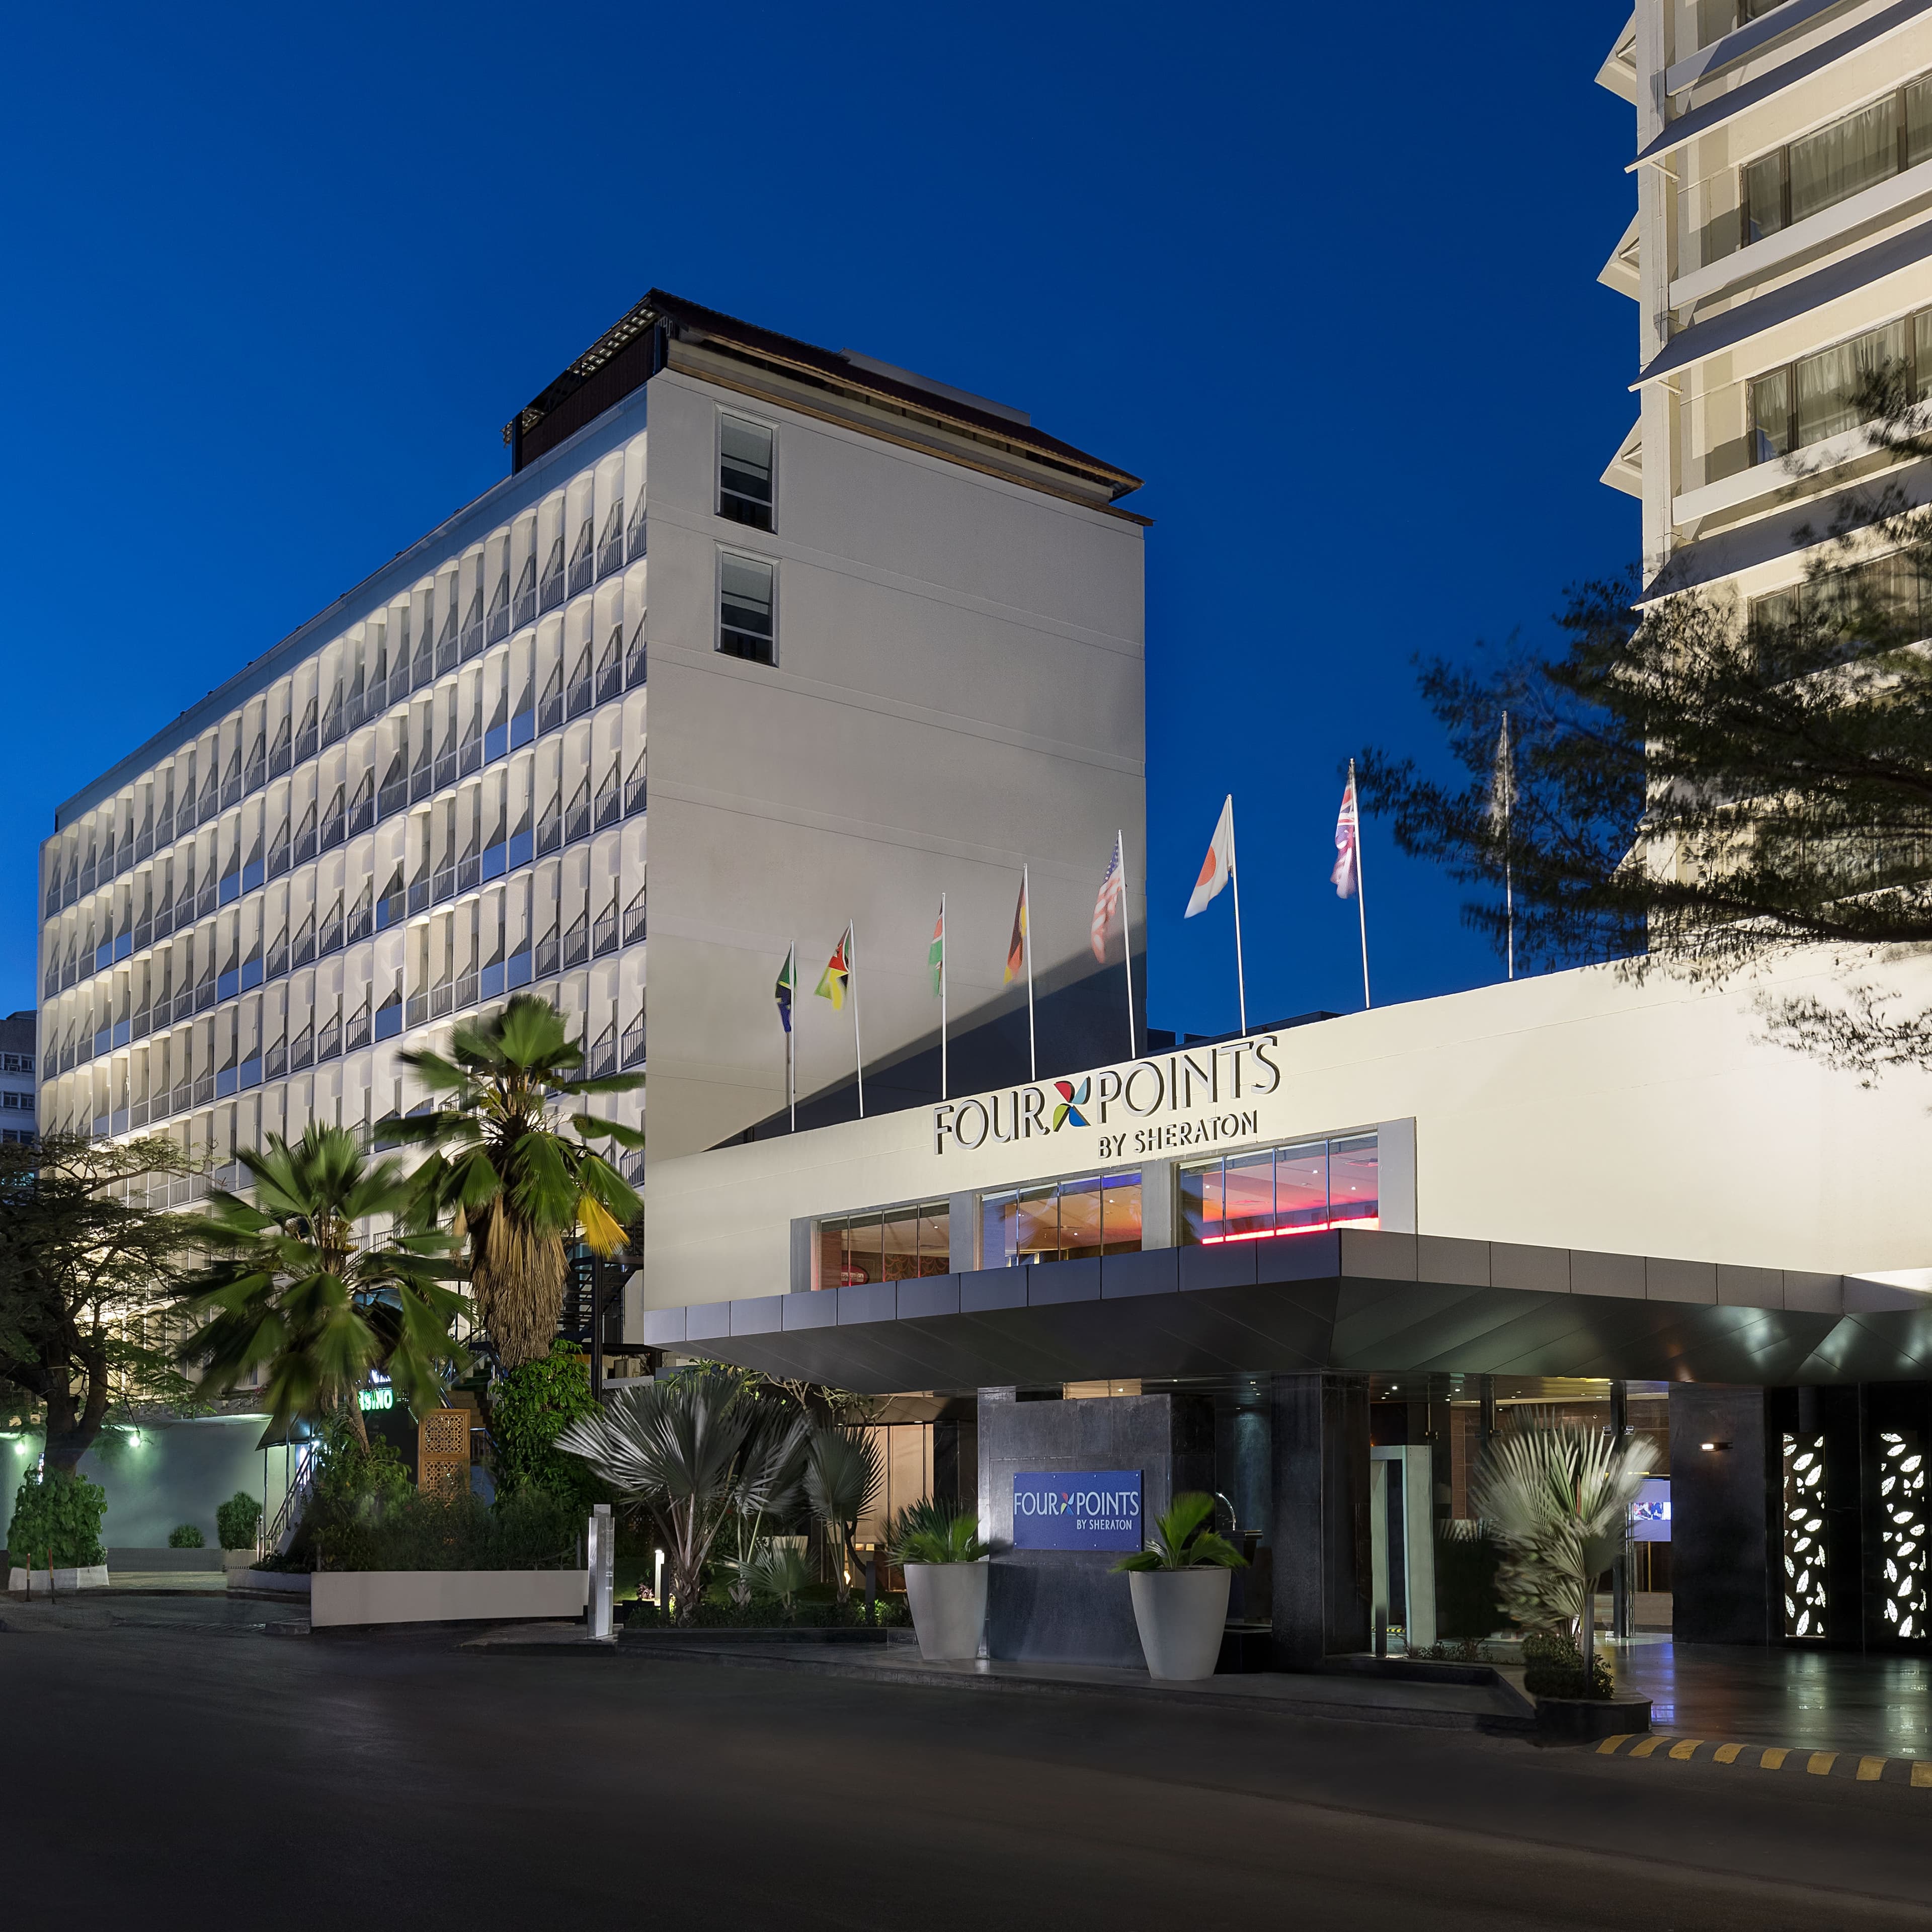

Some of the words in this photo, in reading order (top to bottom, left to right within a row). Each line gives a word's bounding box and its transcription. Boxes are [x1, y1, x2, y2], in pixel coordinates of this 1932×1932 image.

[934, 1086, 1050, 1155] FOUR
[1097, 1035, 1280, 1123] POINTS
[1098, 1133, 1126, 1159] BY
[1134, 1110, 1257, 1153] SHERATON
[1014, 1492, 1059, 1515] FOUR
[1077, 1491, 1139, 1516] POINTS
[1077, 1519, 1087, 1530] BY
[1089, 1519, 1132, 1530] SHERATON
